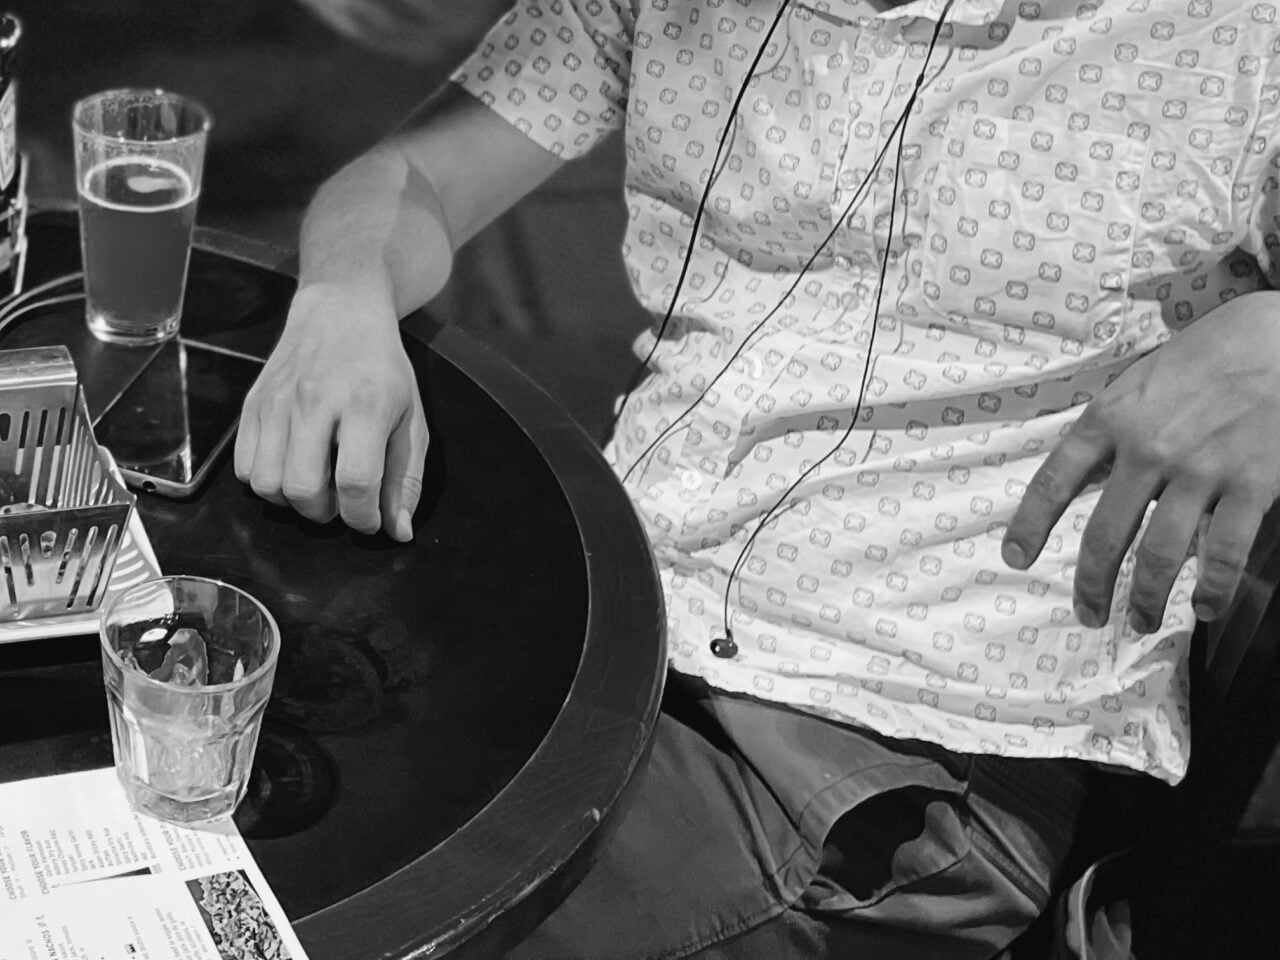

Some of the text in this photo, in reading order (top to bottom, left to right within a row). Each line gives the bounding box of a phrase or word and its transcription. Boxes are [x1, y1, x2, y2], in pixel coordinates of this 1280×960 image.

[162, 830, 175, 845] YOUR
[20, 830, 50, 894] CHOOSE YOUR FLAVOR
[169, 847, 187, 870] CHOOSE
[3, 876, 17, 899] CHOOSE
[41, 930, 57, 956] NACHOS
